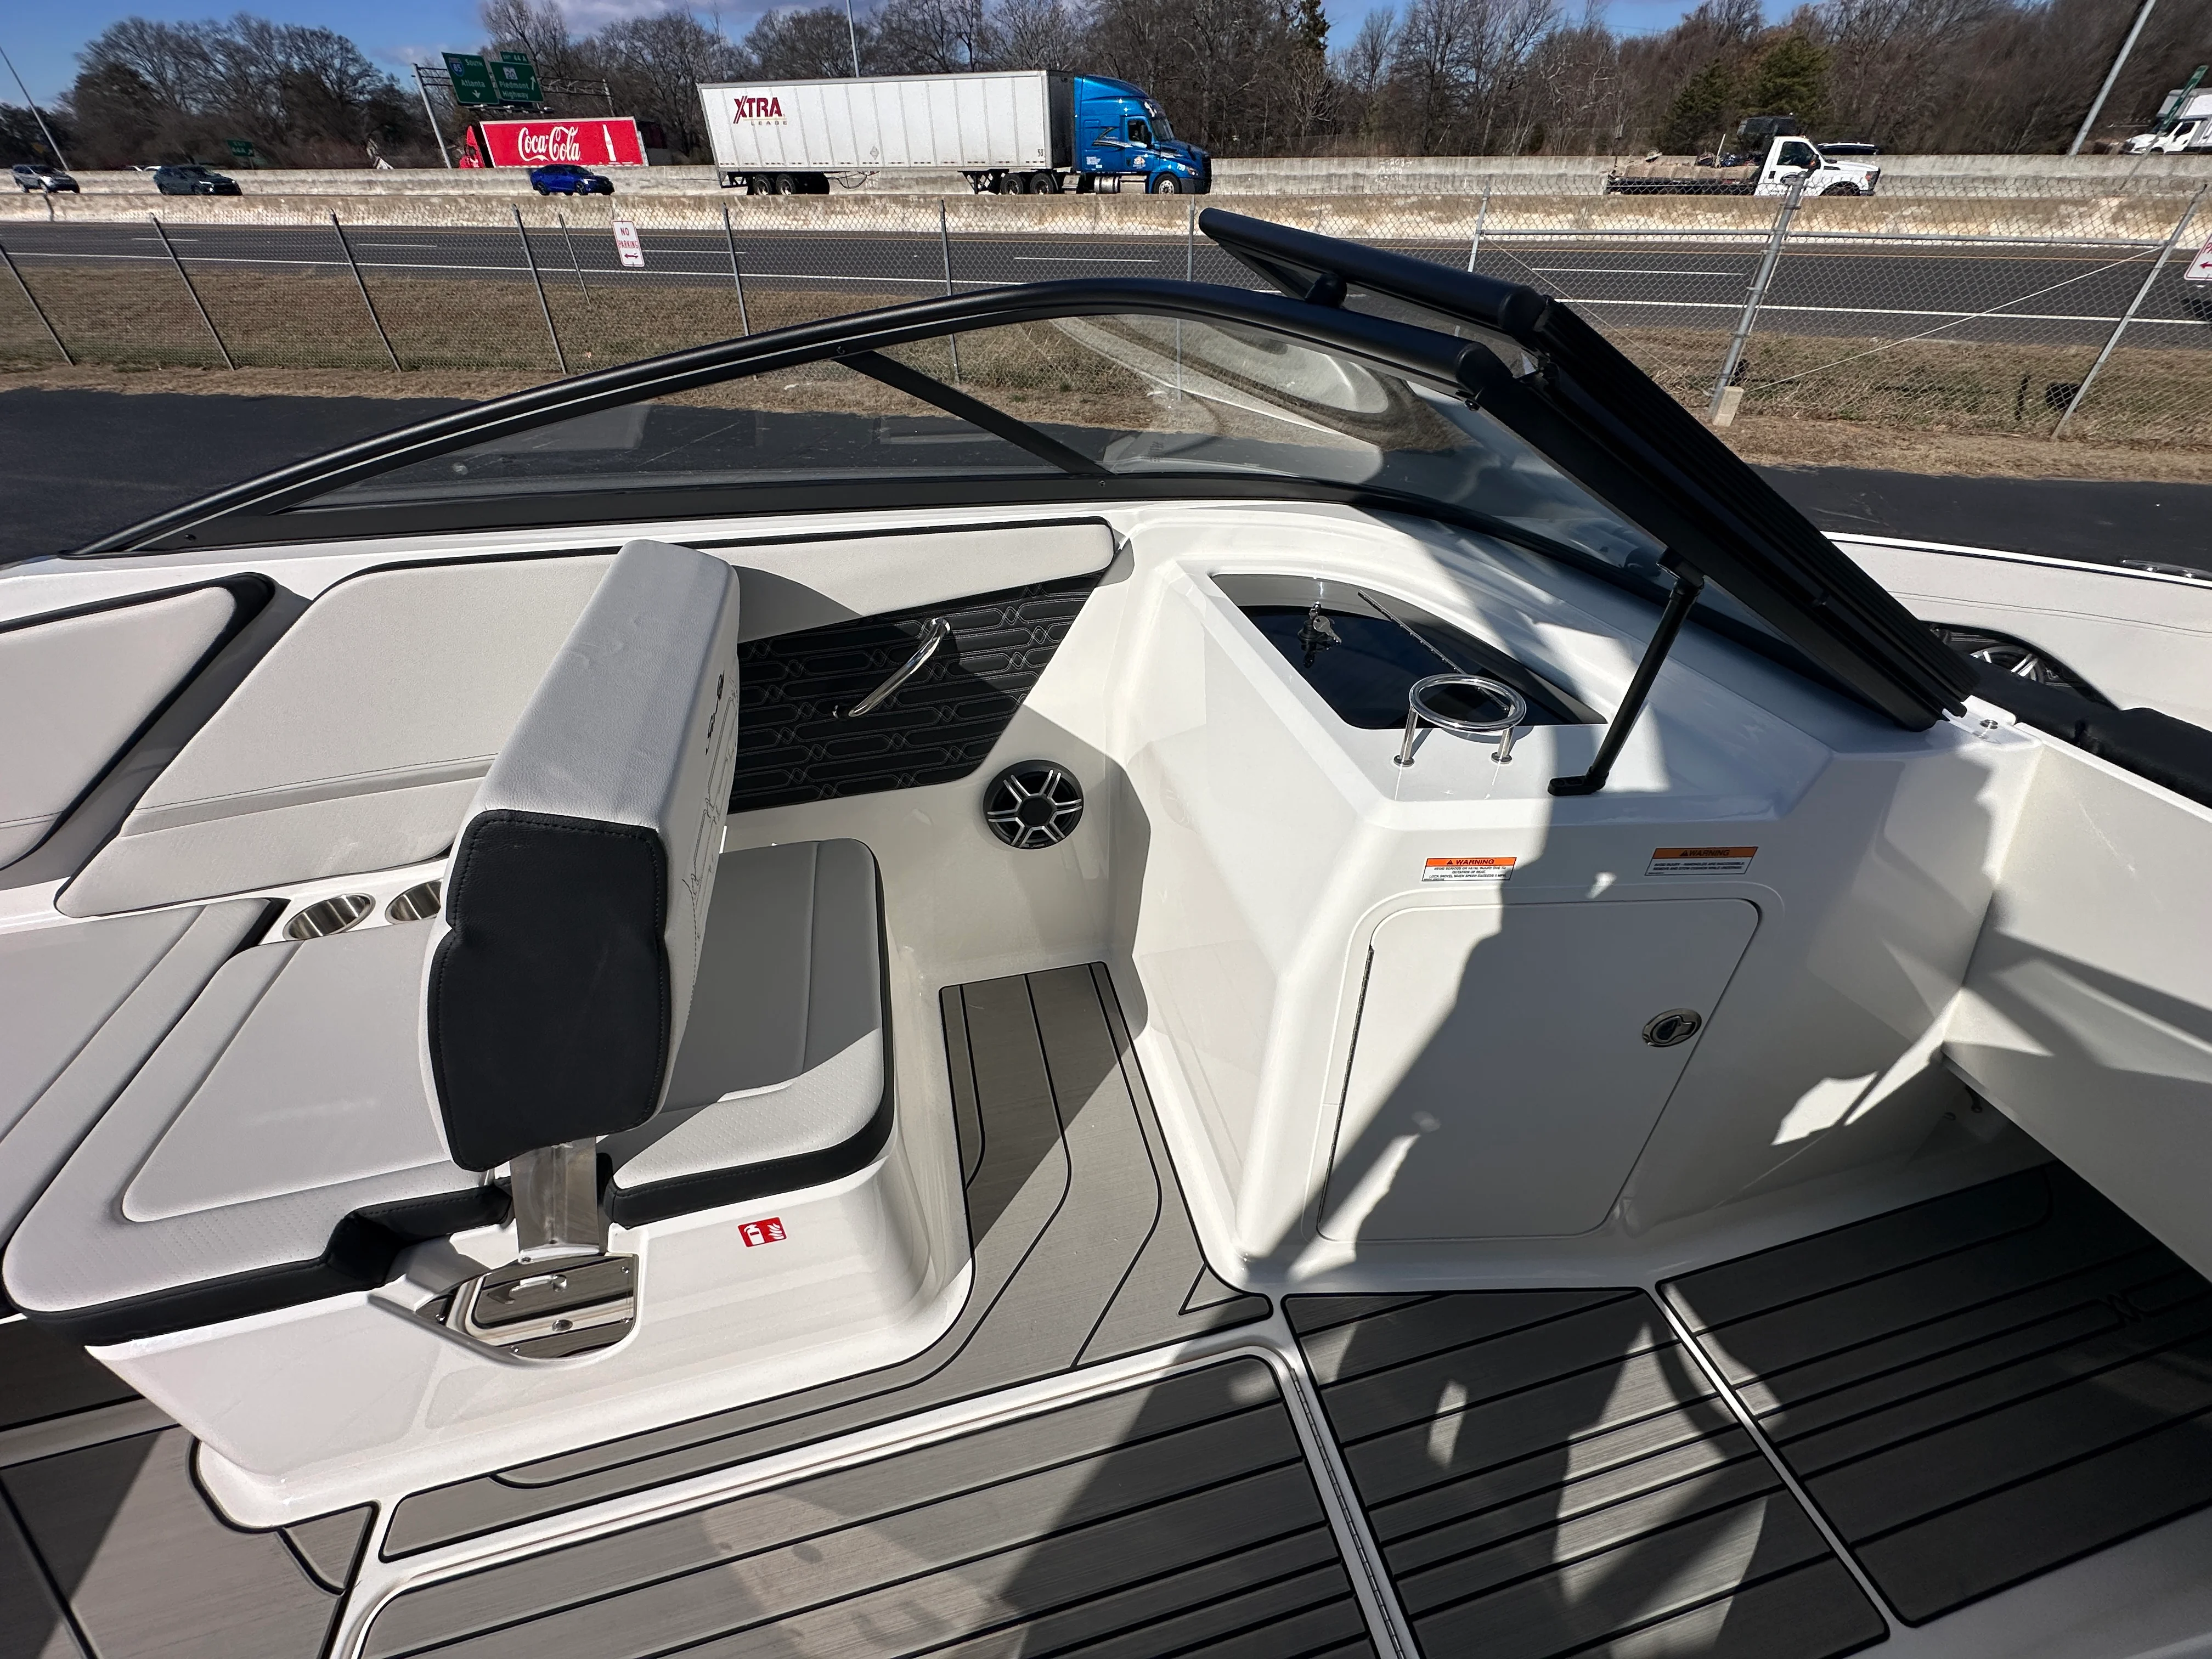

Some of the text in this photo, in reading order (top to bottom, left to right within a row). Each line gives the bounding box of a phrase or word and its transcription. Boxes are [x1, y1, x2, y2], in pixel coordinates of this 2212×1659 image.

[453, 63, 462, 72] 85
[461, 79, 486, 88] Atlanta
[499, 81, 530, 90] Piedmont
[502, 91, 529, 100] Highway
[733, 95, 783, 124] XTRA
[518, 126, 582, 162] Coca-Cola
[620, 227, 630, 236] NO
